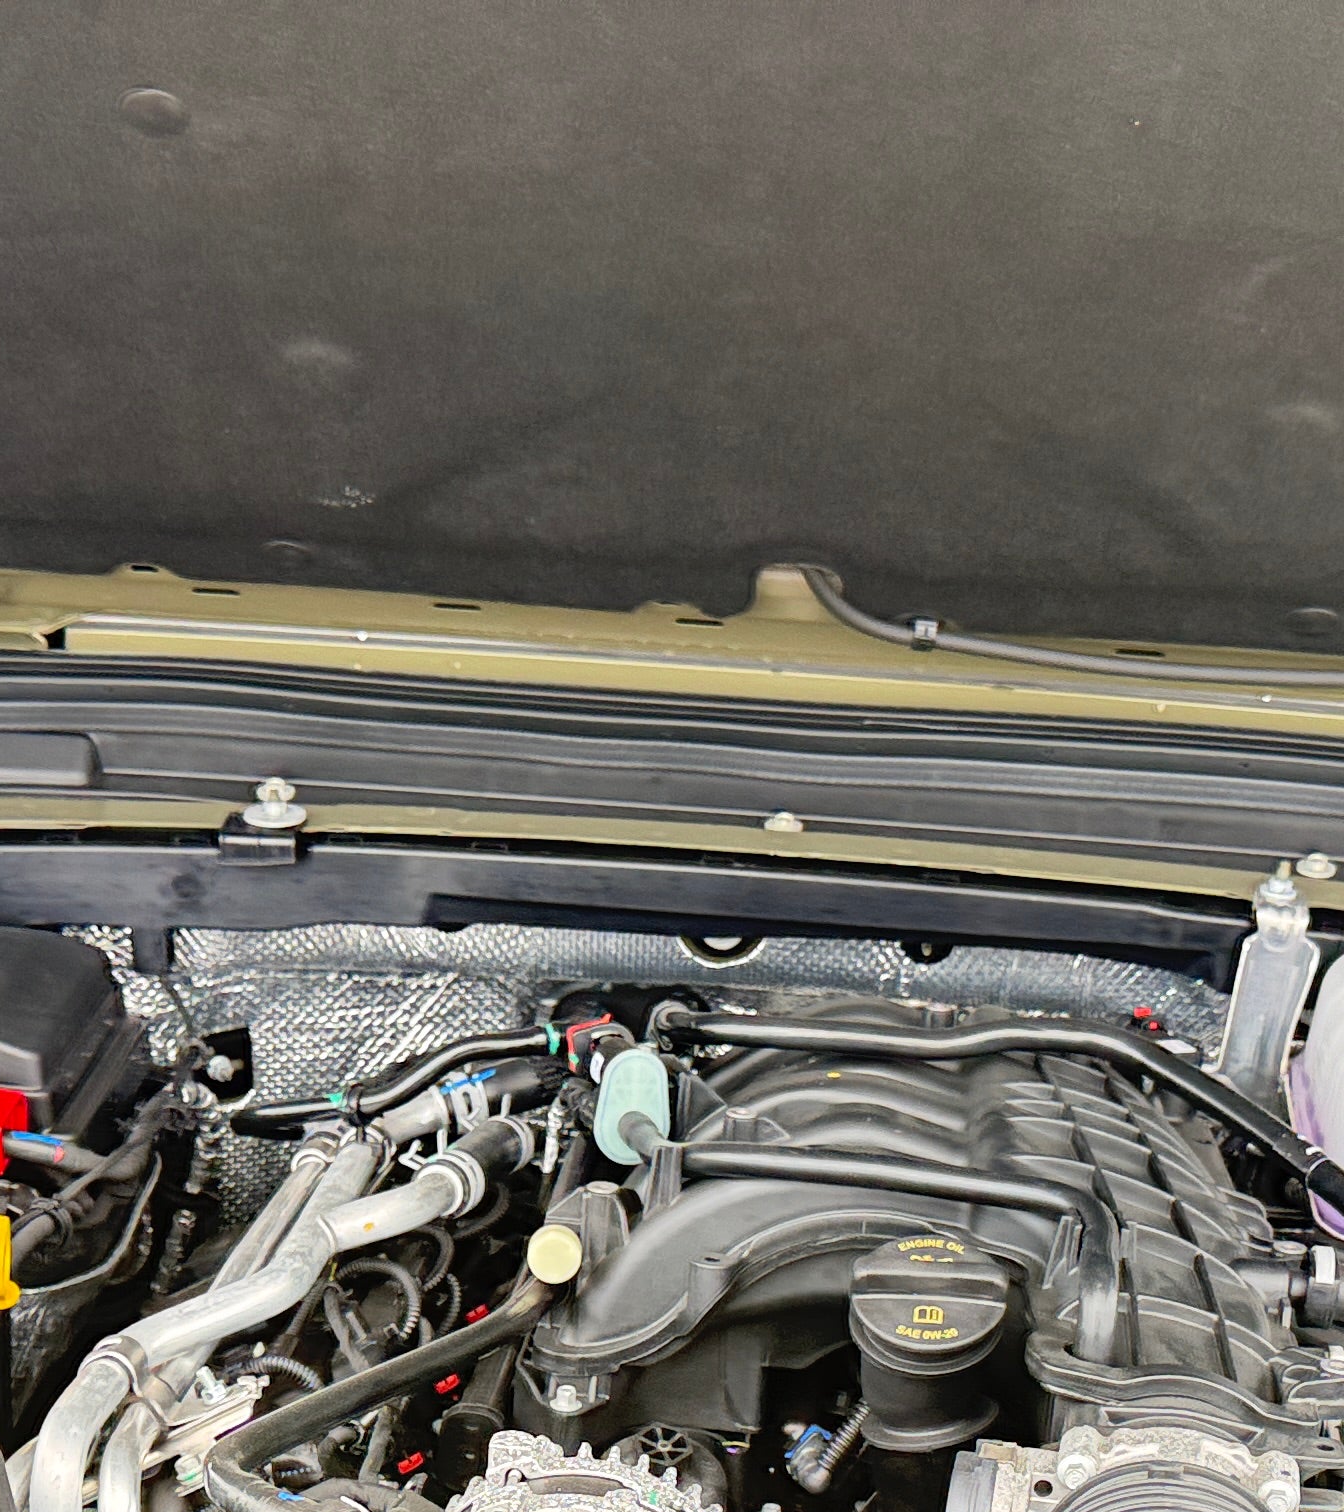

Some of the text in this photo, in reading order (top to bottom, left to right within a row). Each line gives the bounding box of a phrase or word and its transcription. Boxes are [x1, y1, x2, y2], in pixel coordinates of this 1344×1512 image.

[897, 1239, 965, 1255] ENGINE OIL
[895, 1324, 922, 1339] SAE
